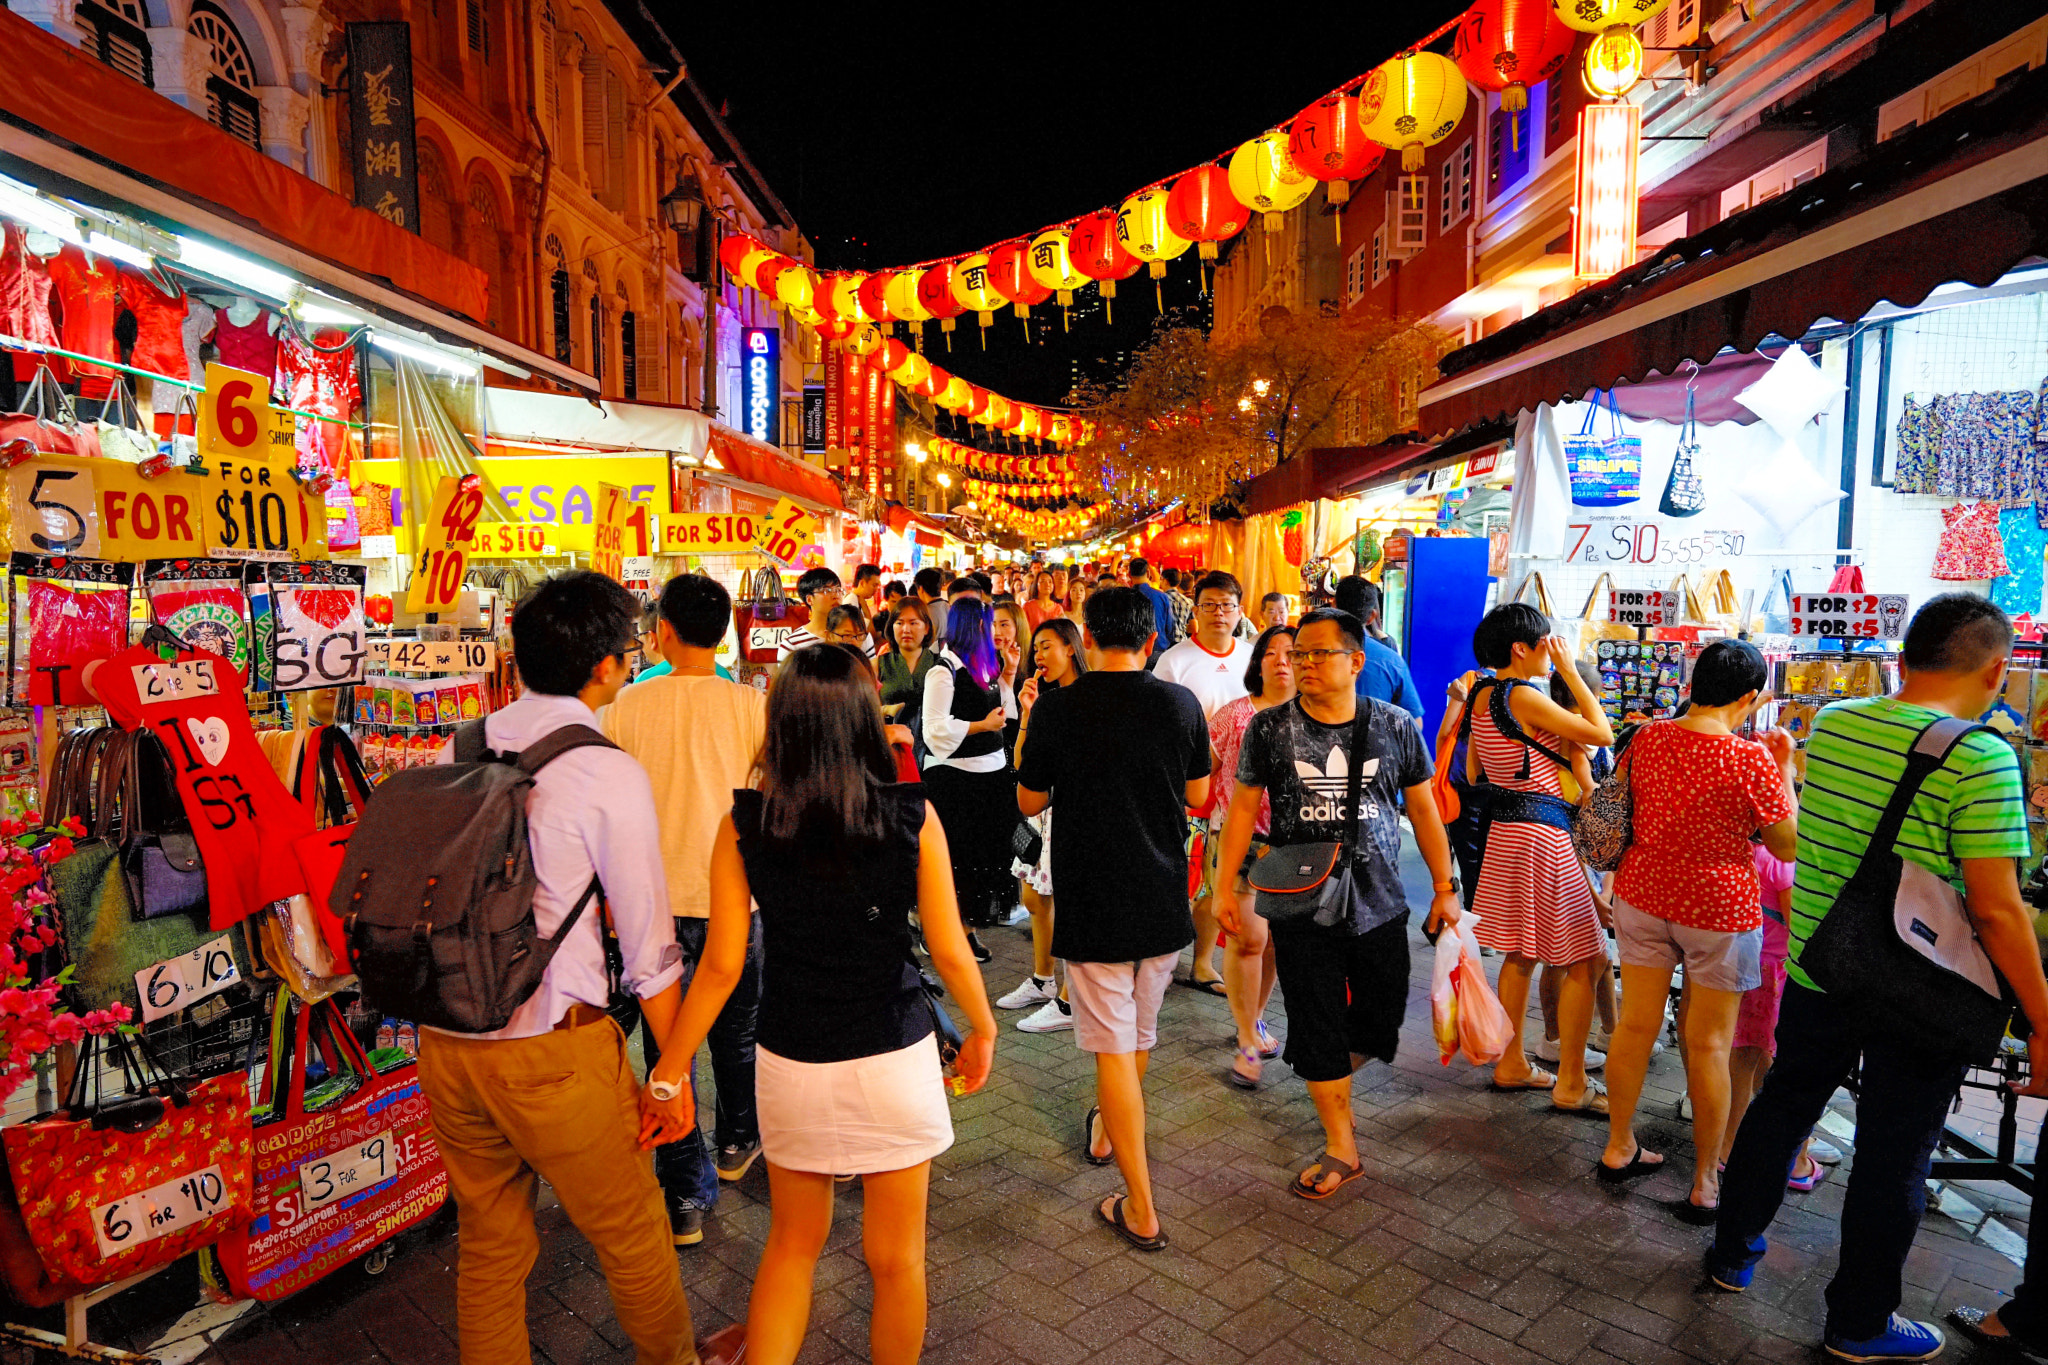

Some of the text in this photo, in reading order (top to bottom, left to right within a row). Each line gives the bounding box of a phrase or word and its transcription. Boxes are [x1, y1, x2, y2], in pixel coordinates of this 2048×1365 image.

[1032, 240, 1060, 269] 酉
[961, 264, 987, 291] 酉
[804, 377, 824, 385] Nikon
[868, 372, 877, 422] CHINATOWN
[216, 380, 258, 447] 6
[814, 398, 822, 441] Digitronics
[828, 392, 837, 441] HERITAGE
[267, 430, 296, 447] SHIRT
[868, 425, 877, 464] HERITAGE
[219, 462, 272, 487] FOR
[1469, 454, 1495, 472] Canon
[28, 470, 194, 551] 5 FOR
[216, 489, 289, 550] $10
[441, 490, 484, 542] 42
[608, 489, 619, 524] 7
[783, 505, 805, 530] 7
[498, 525, 545, 554] $10
[597, 524, 622, 551] FOR
[625, 505, 648, 557] 1
[667, 525, 701, 543] FOR
[706, 516, 753, 545] $10
[794, 528, 807, 541] FOR
[1567, 524, 1592, 563] 7
[1585, 545, 1599, 562] Pcs
[35, 556, 45, 568] I
[633, 568, 651, 577] FREE
[1610, 591, 1662, 607] 1 FOR $2
[1792, 595, 1879, 614] 1 FOR $2
[1610, 608, 1662, 624] 3 FOR $5
[1792, 618, 1879, 636] 3 FOR $5
[374, 643, 390, 659] $9
[752, 628, 764, 646] 6
[274, 631, 365, 687] SG
[395, 643, 426, 668] 42
[458, 644, 486, 667] $10
[142, 665, 163, 696] 2
[184, 662, 213, 690] $5
[159, 717, 202, 772] I
[147, 966, 180, 1008] 6
[311, 1162, 335, 1201] 3
[338, 1168, 358, 1186] FOR
[360, 1139, 385, 1177] $9
[103, 1172, 222, 1241] 6 FOR $10
[289, 1203, 339, 1238] SINGAPORE
